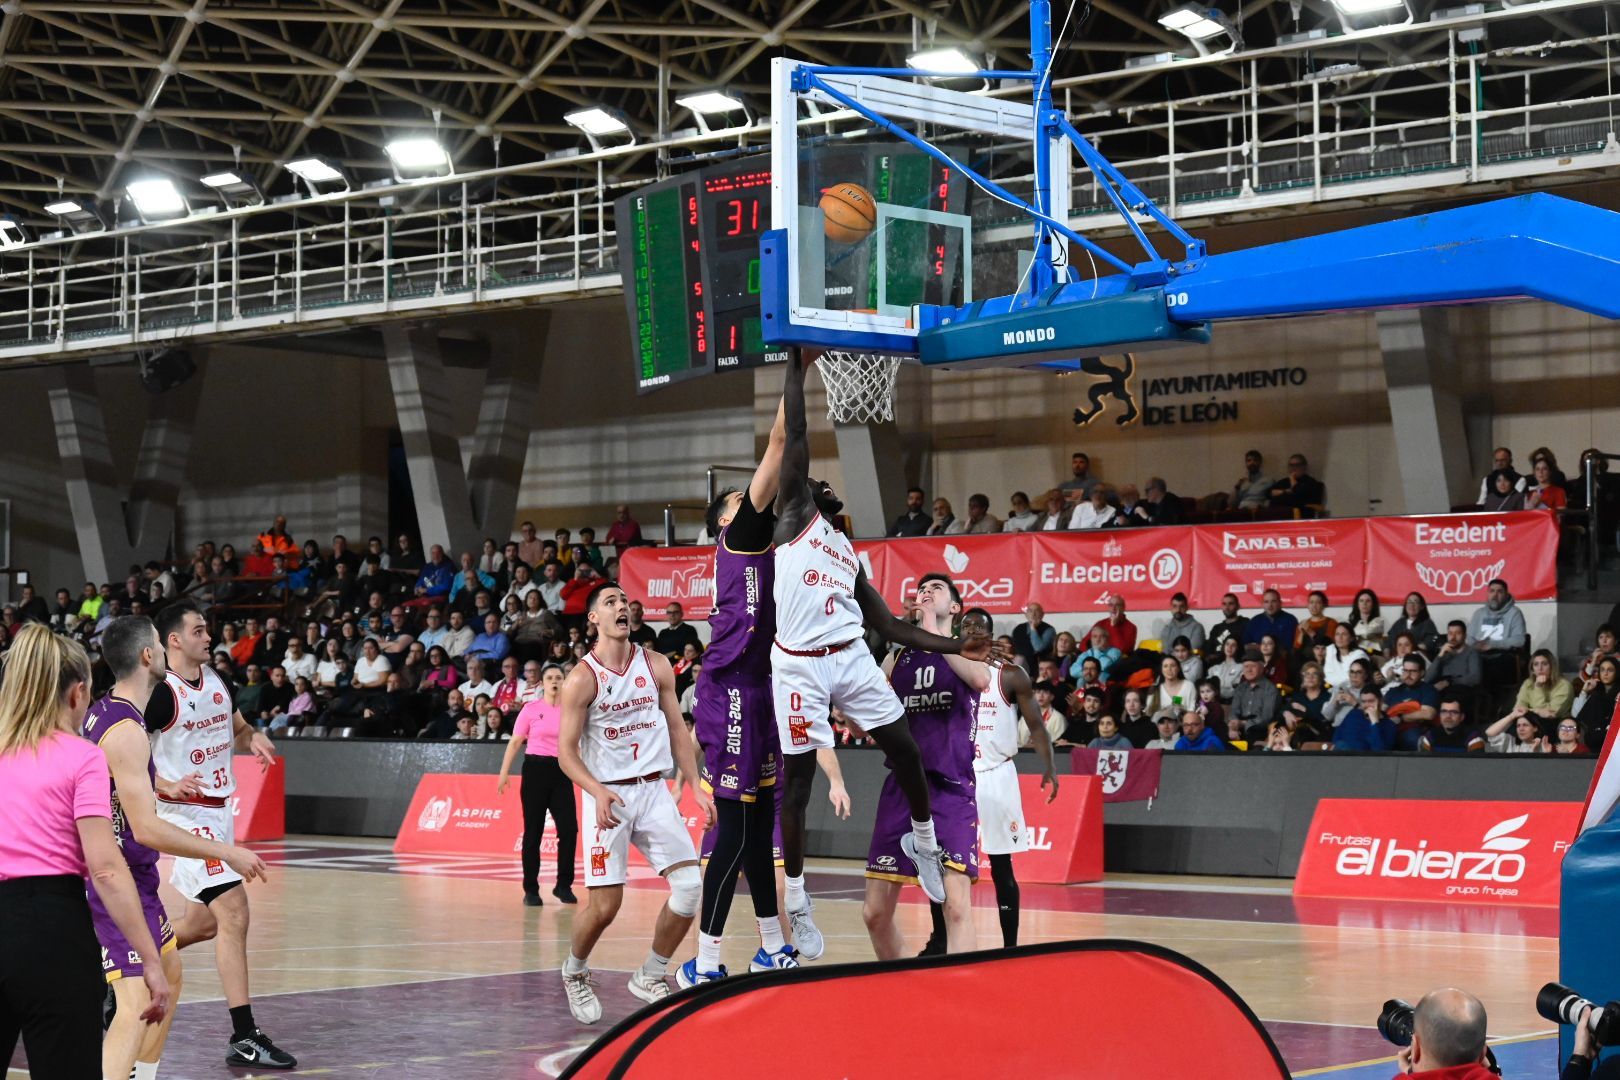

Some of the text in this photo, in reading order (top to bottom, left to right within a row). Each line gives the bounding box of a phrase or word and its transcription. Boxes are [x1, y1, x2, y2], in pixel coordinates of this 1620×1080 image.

[727, 199, 759, 236] 31
[1003, 326, 1056, 346] MONDO
[717, 356, 739, 367] FALTAS
[640, 375, 671, 389] MONDO
[1149, 367, 1308, 397] AYUNTAMIENTO
[1150, 396, 1239, 426] DE LEÓN
[1415, 521, 1506, 544] Ezedent
[822, 545, 840, 561] CAJA
[1429, 547, 1493, 559] Smile Designers
[1041, 561, 1147, 583] E.Leclerc
[744, 566, 756, 604] aspasia
[825, 596, 835, 616] 0
[1480, 623, 1504, 641] 72
[913, 665, 936, 690] 10
[611, 701, 631, 711] CAJA
[630, 695, 655, 706] RURAL
[790, 692, 802, 712] 0
[196, 718, 212, 729] CAJA
[619, 720, 657, 734] E.Leclerc
[726, 688, 742, 755] 2015-2025
[630, 743, 639, 761] 7
[212, 767, 228, 789] 33
[720, 773, 739, 786] CBC
[453, 808, 502, 820] ASPIRE
[455, 821, 490, 829] ACADEMY
[1319, 832, 1373, 846] Frutas
[870, 864, 899, 872] HYUNDAI
[1335, 838, 1526, 884] el bierzo
[1446, 884, 1519, 897] grupo fruasa
